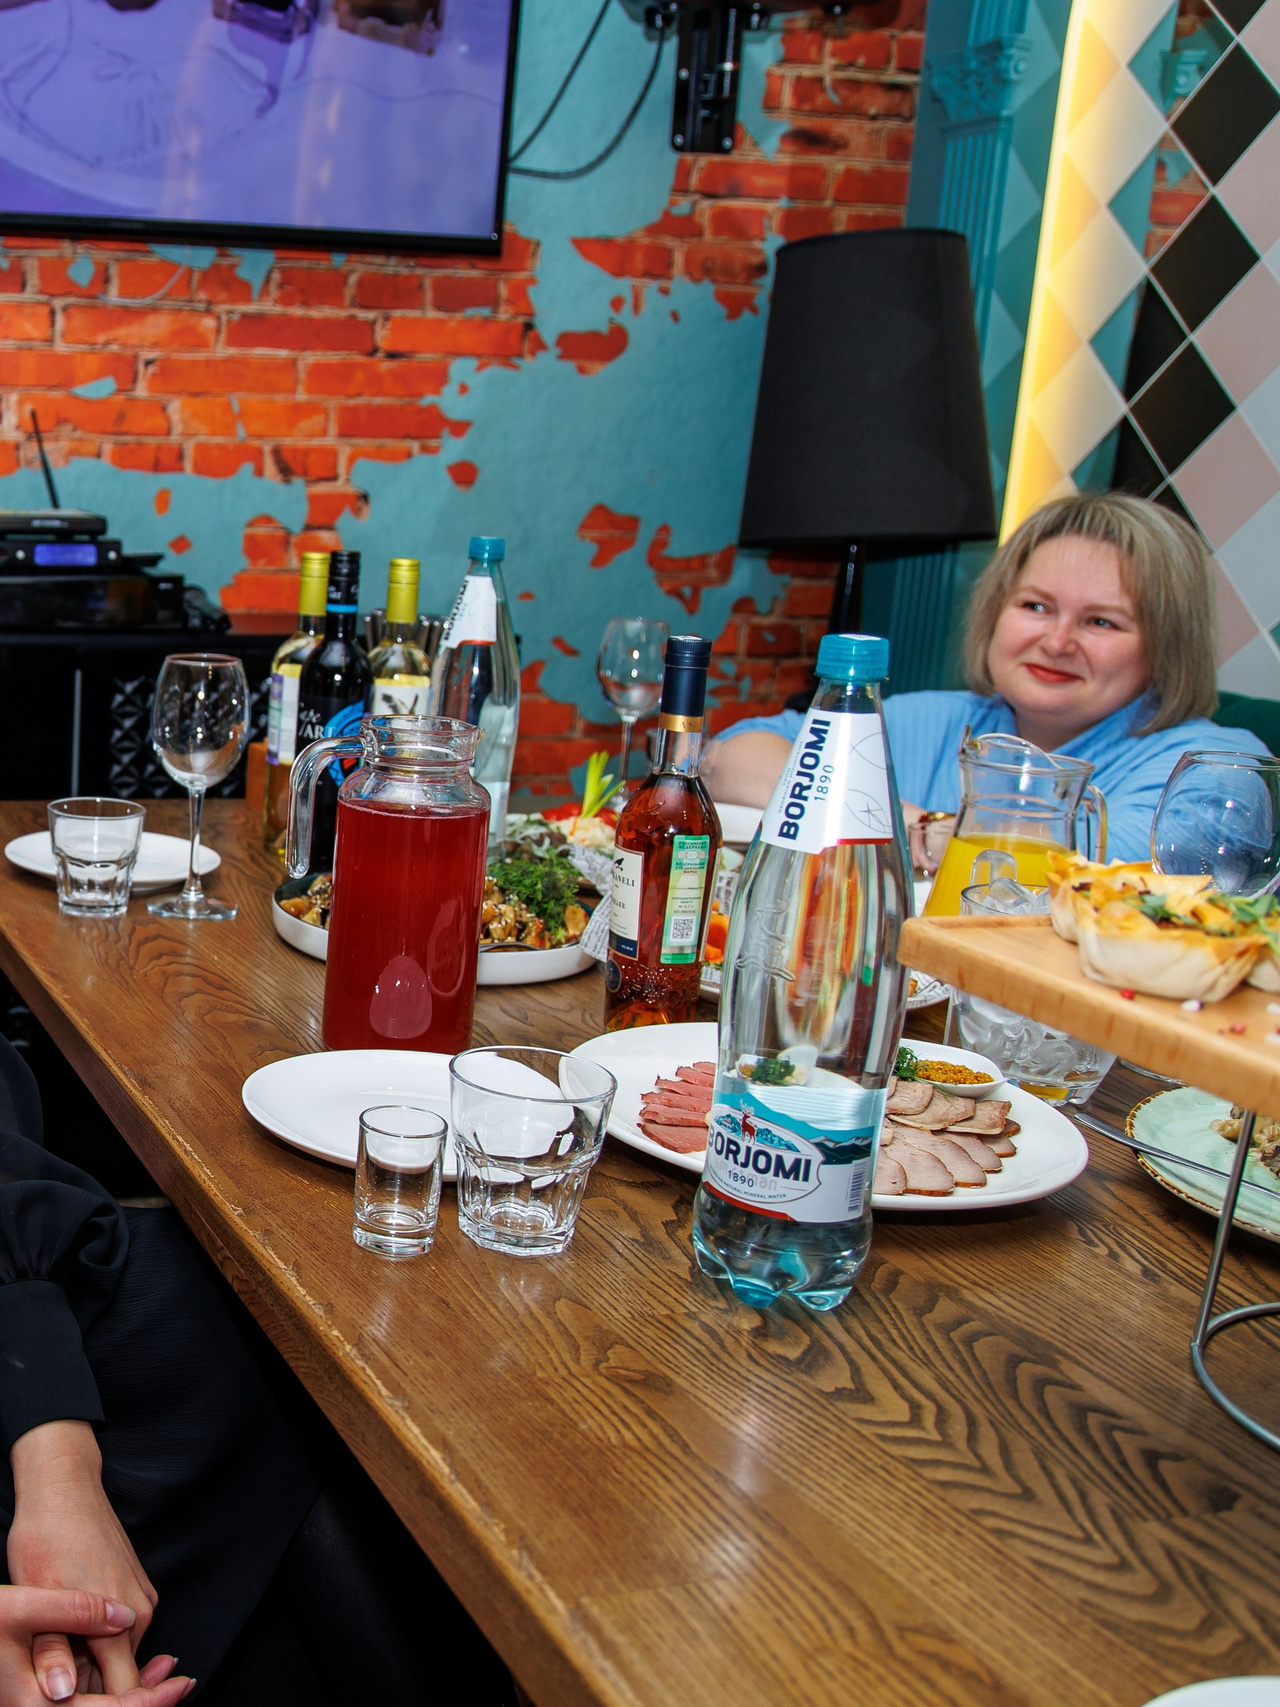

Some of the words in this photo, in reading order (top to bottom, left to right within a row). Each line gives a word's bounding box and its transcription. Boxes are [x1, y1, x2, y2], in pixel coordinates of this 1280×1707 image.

[778, 718, 832, 841] BORJOMI
[814, 764, 836, 802] 1890
[708, 1123, 813, 1183] BORJOMI
[728, 1169, 755, 1188] 1890
[743, 1190, 767, 1200] MINERAL
